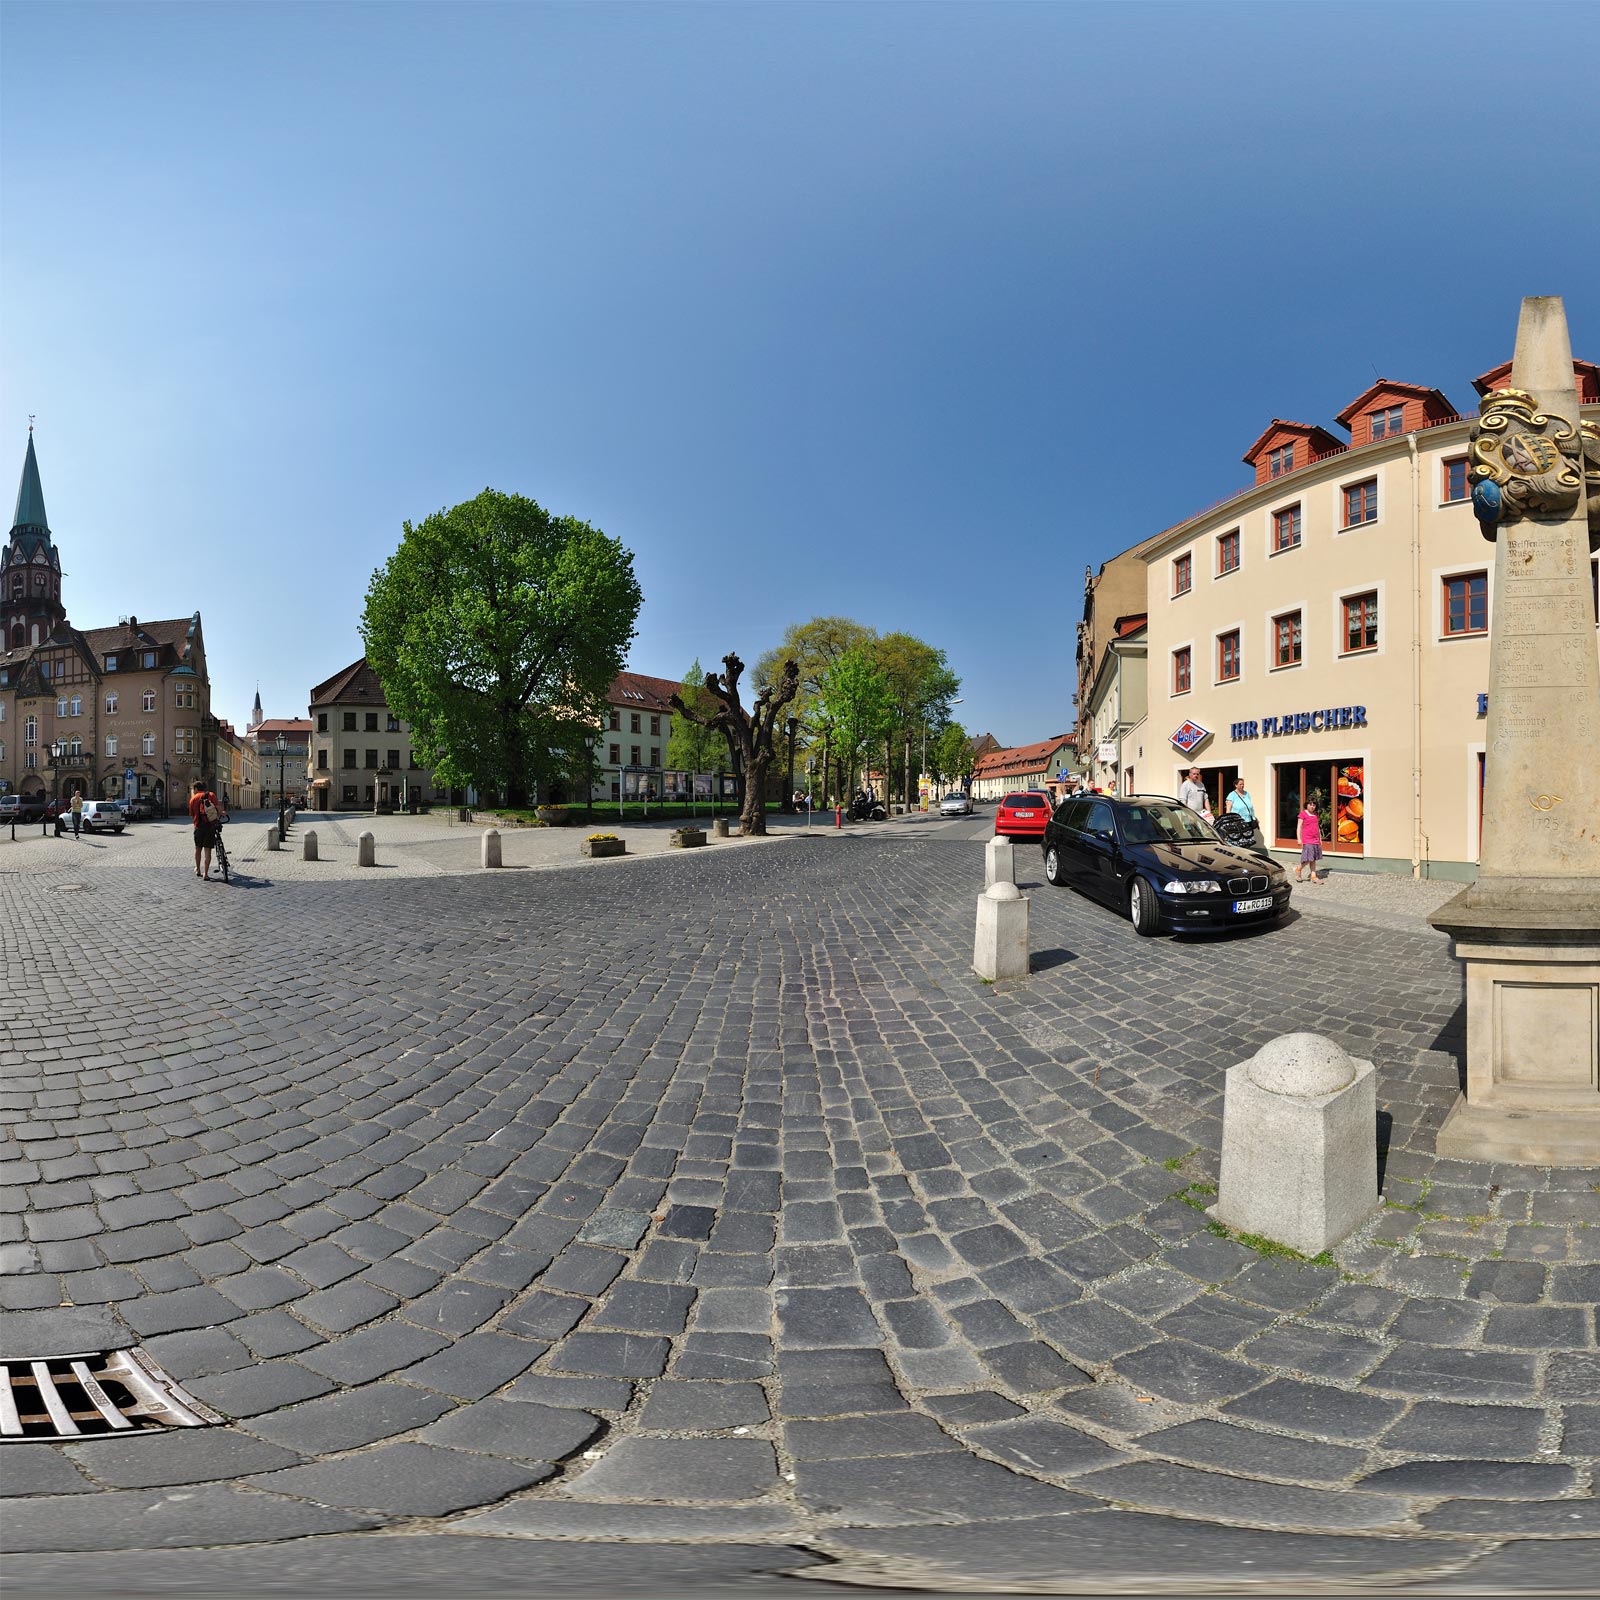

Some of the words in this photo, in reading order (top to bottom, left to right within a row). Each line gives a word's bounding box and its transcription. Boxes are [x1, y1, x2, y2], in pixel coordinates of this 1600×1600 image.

[1230, 720, 1258, 738] IHR
[1261, 705, 1367, 735] FLEISCHER
[1177, 728, 1201, 744] Wolf
[1532, 817, 1559, 831] 1725
